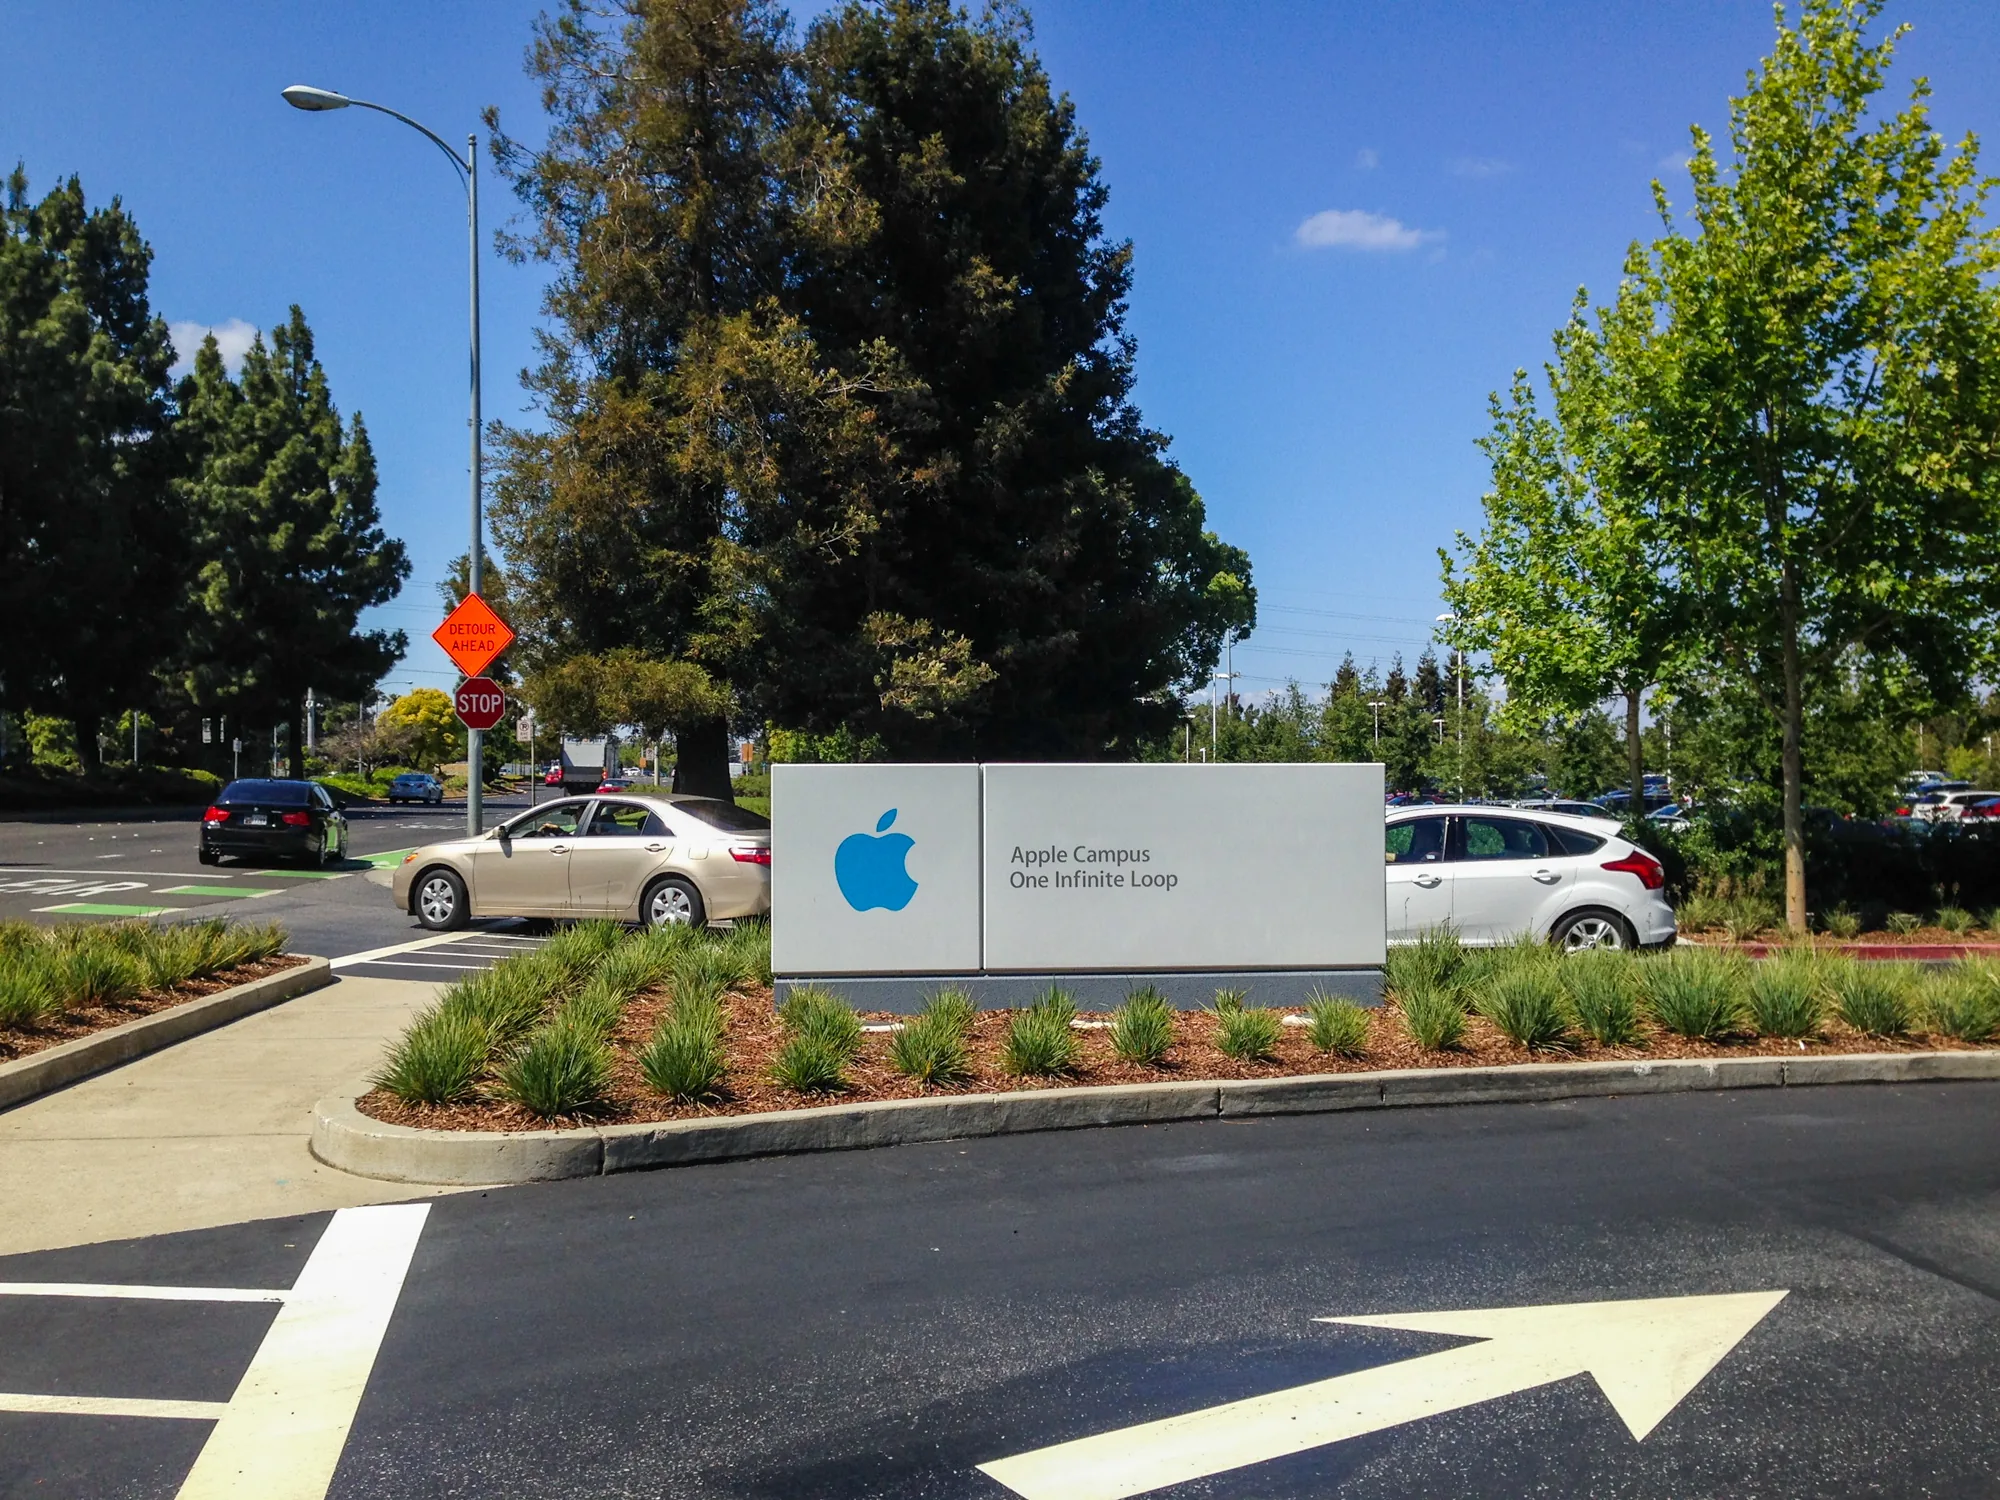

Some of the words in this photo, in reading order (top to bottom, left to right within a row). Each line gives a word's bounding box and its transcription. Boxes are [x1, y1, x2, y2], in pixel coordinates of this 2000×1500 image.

[449, 623, 496, 635] DETOUR
[452, 640, 495, 651] AHEAD
[459, 694, 501, 713] STOP
[1010, 845, 1068, 867] Apple
[1073, 845, 1151, 867] Campus
[1009, 871, 1049, 889] One
[1055, 869, 1125, 888] Infinite
[1131, 870, 1179, 891] Loop
